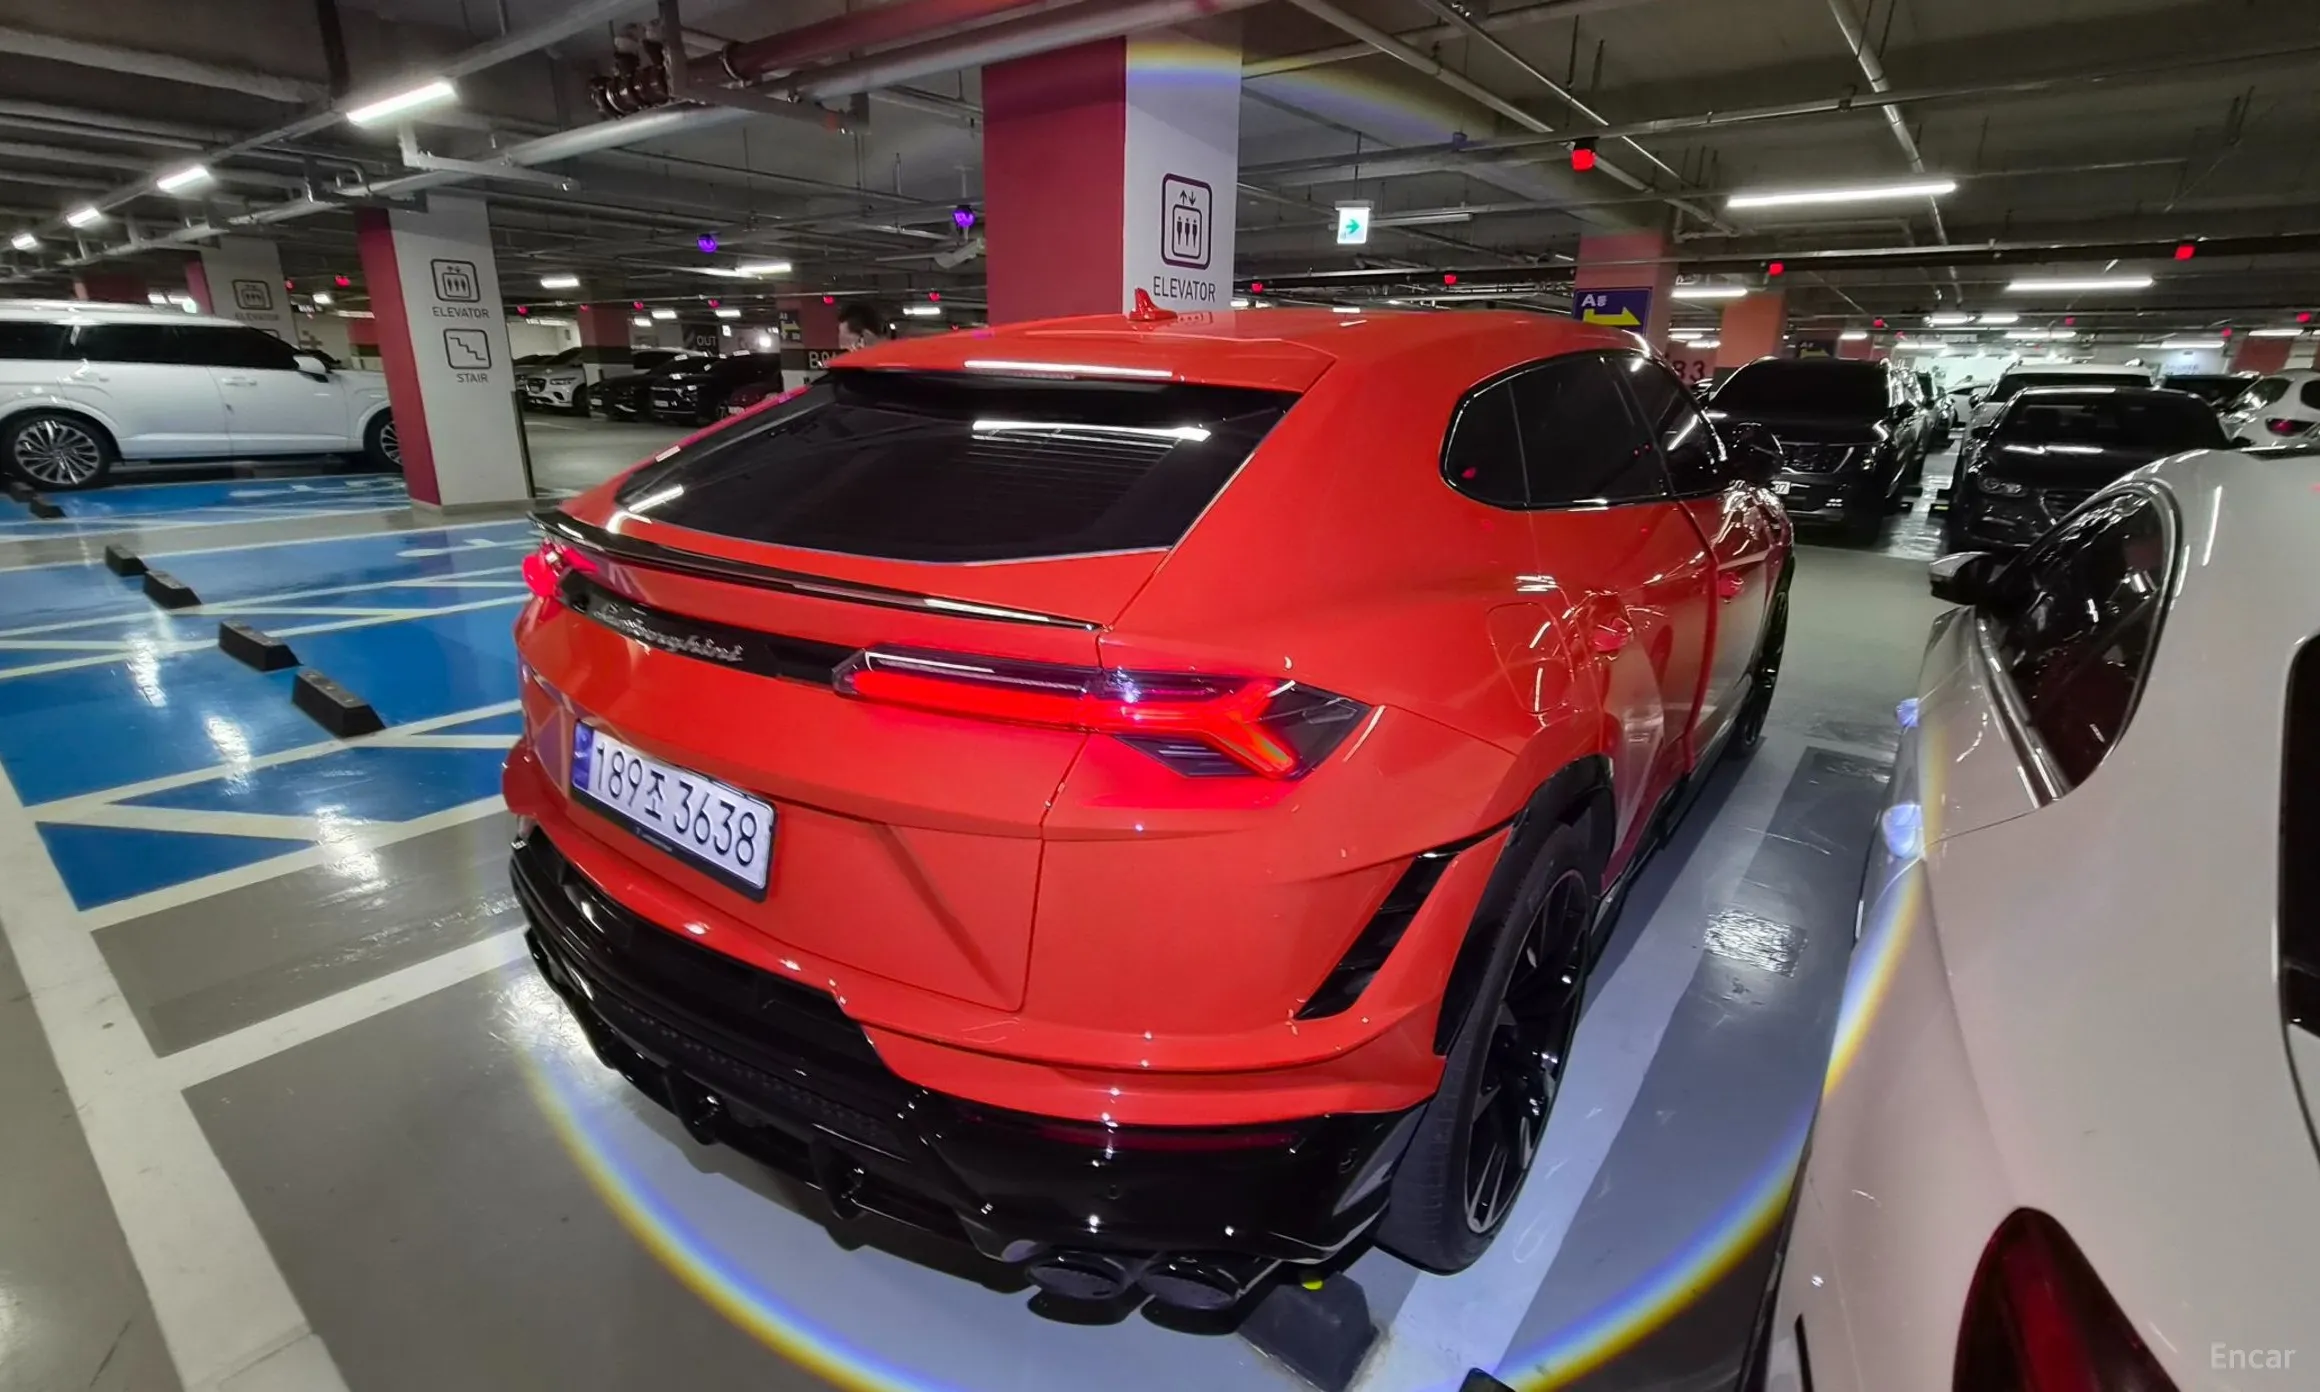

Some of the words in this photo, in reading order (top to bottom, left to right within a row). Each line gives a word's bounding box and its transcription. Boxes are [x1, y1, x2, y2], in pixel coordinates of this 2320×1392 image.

[1153, 275, 1216, 303] ELEVATOR
[432, 306, 490, 319] ELEVATOR
[697, 335, 716, 346] OUT
[456, 373, 489, 383] STAIR
[596, 742, 665, 822] 189조
[673, 779, 758, 867] 3638
